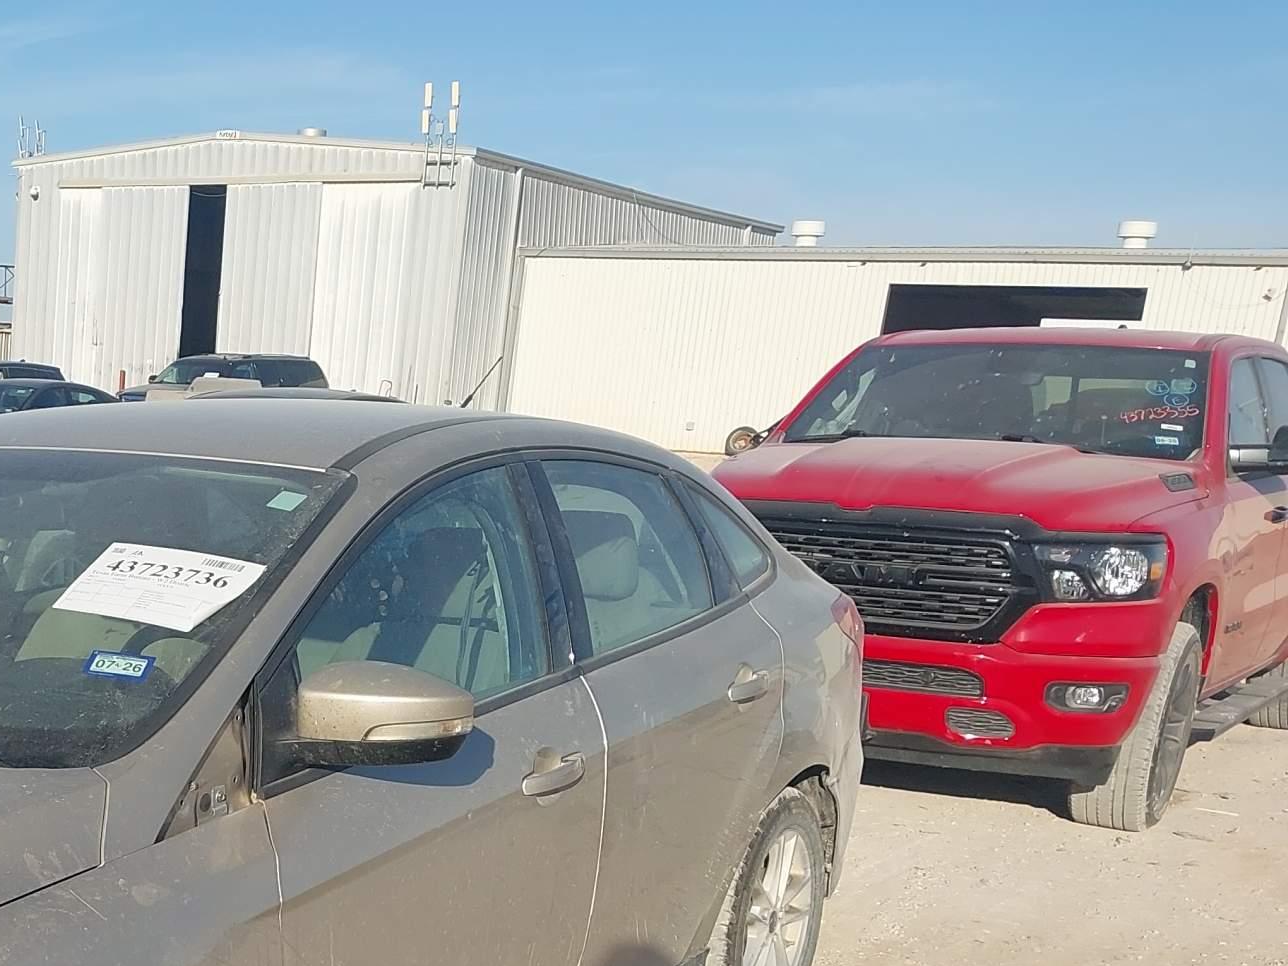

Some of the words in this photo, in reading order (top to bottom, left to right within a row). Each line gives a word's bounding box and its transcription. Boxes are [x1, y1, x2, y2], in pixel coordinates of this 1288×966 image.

[1120, 404, 1200, 423] 43723355
[106, 559, 233, 588] 43723736
[95, 659, 116, 669] 07
[122, 662, 143, 672] 26
